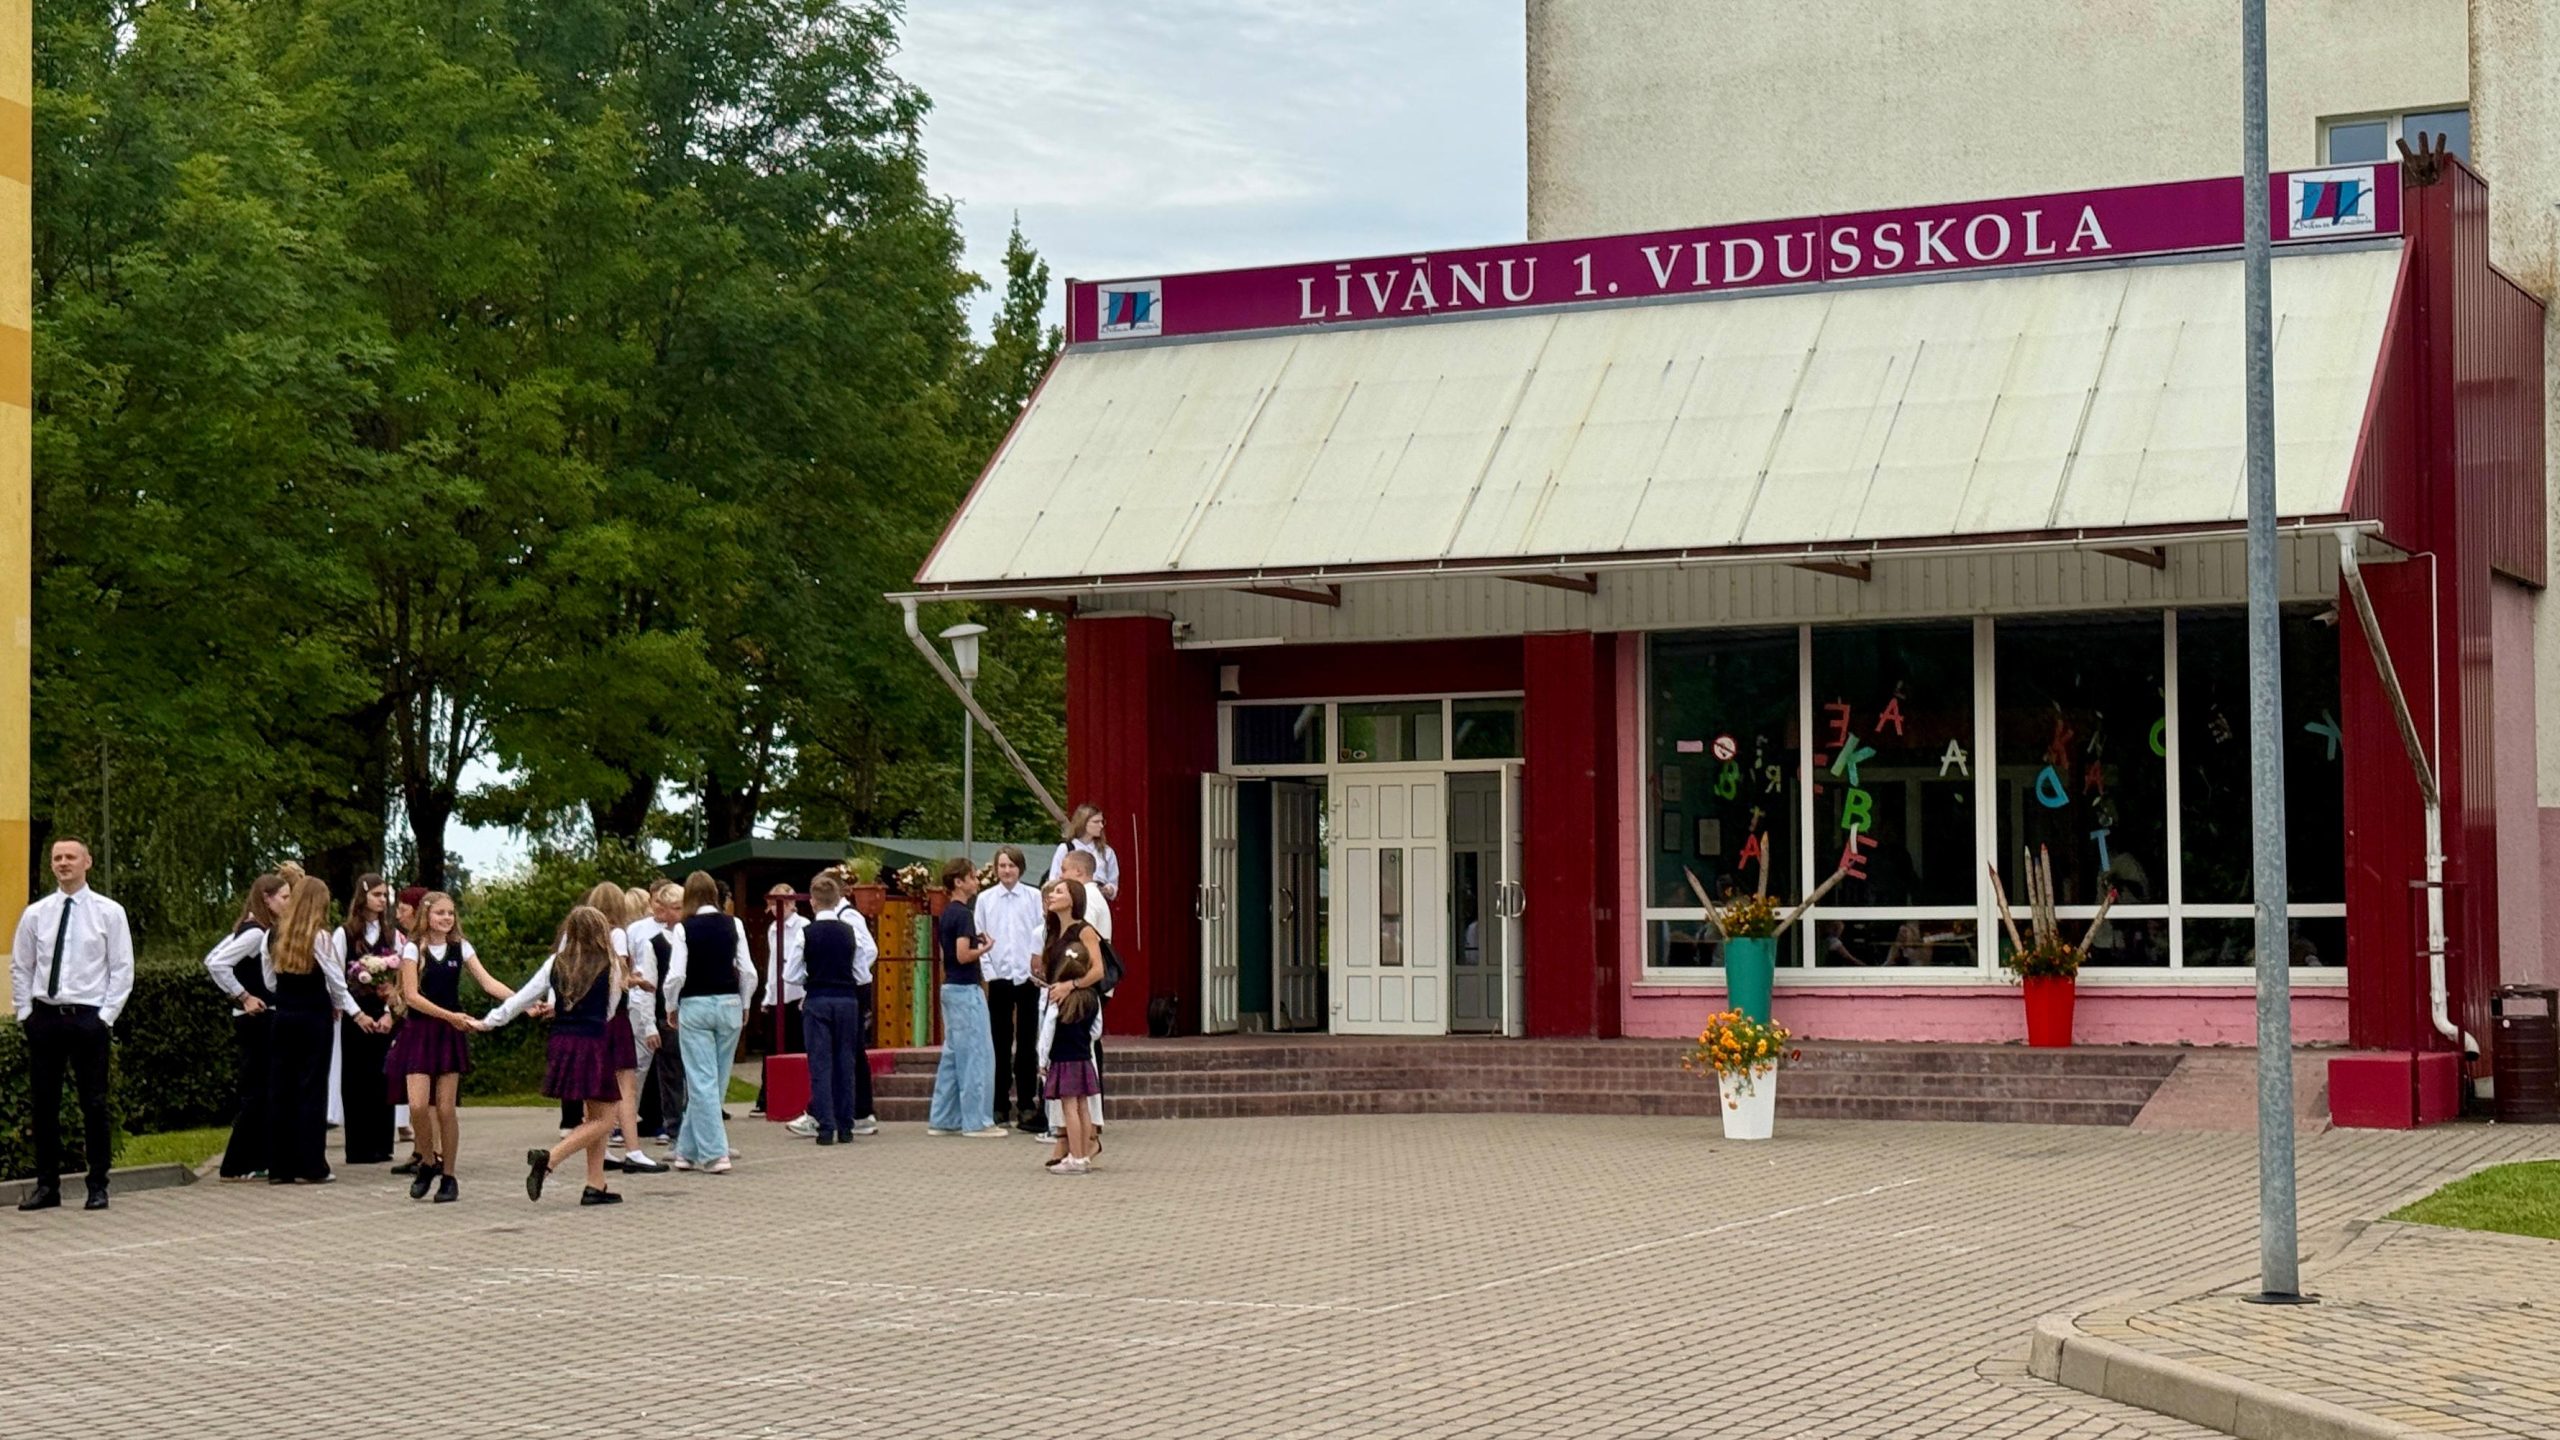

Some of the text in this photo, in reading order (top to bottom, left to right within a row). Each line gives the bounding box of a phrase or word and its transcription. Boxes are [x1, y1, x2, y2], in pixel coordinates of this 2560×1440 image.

[1297, 205, 2112, 319] LĪVĀNU 1. VIDUSSKOLA
[1938, 738, 1969, 777] A
[1841, 788, 1873, 833] B
